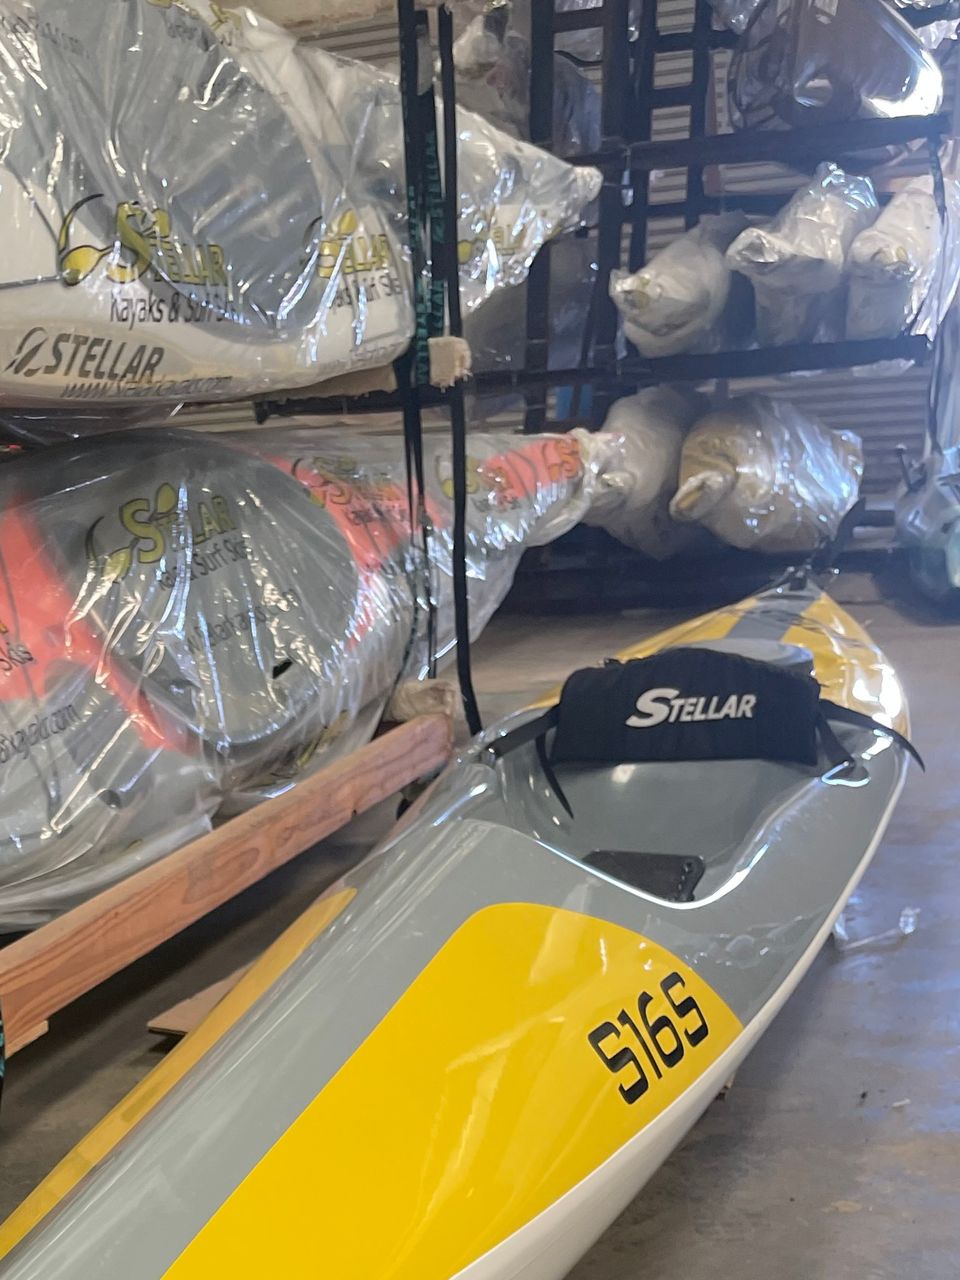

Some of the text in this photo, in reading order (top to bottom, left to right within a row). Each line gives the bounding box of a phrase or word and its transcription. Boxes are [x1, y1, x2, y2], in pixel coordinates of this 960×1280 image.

[44, 333, 165, 384] STELLAR
[626, 686, 757, 729] STELLAR
[587, 971, 710, 1107] S16S
